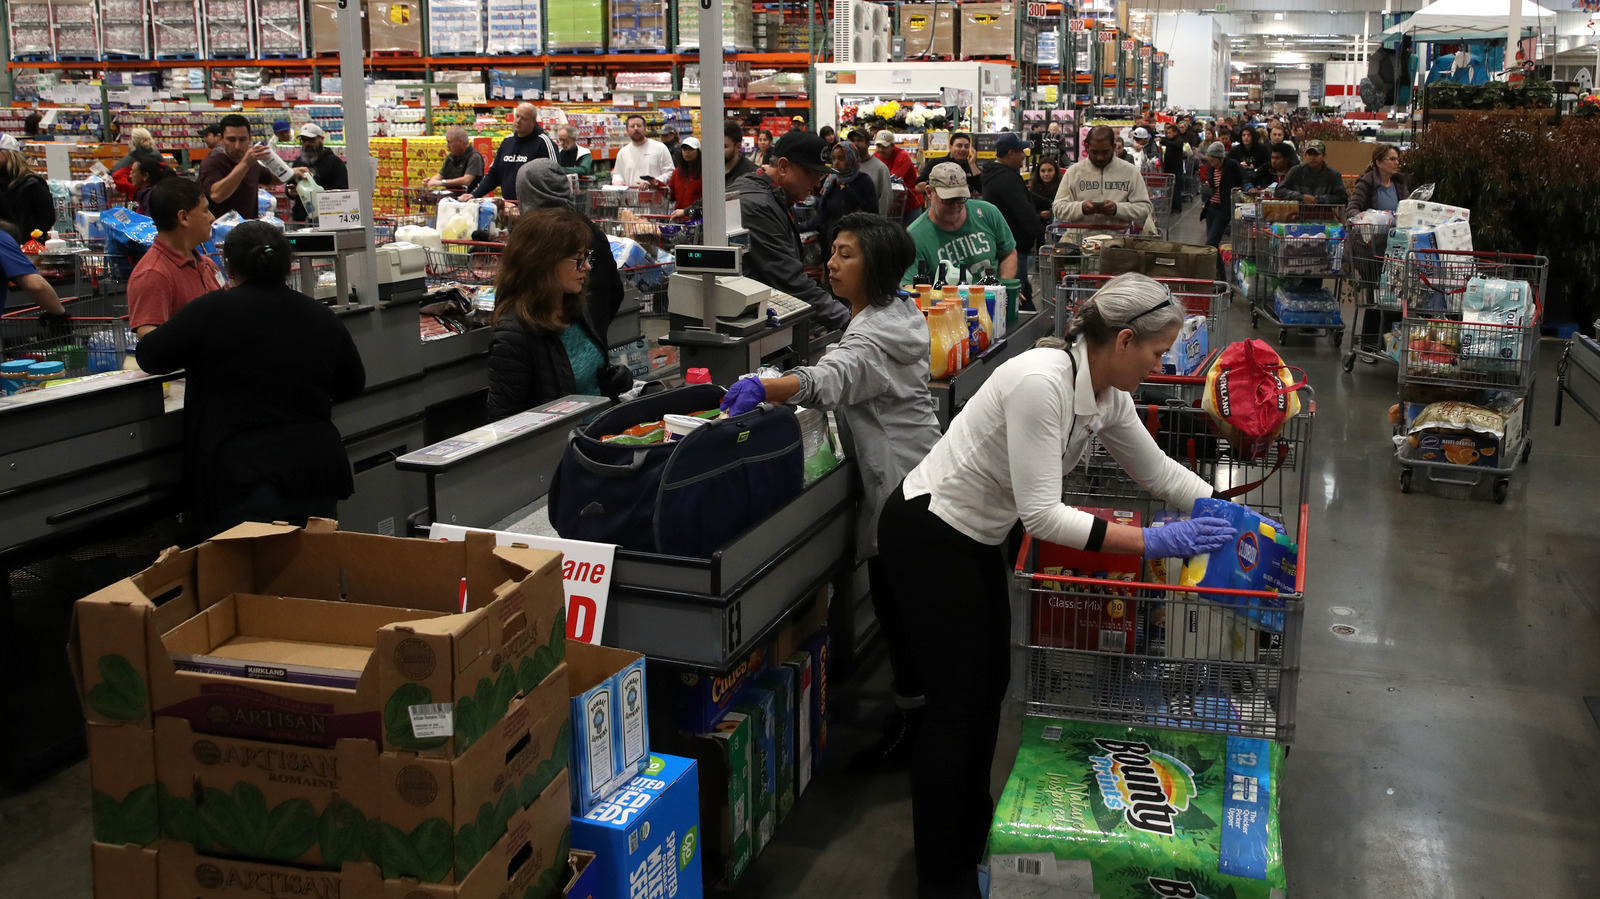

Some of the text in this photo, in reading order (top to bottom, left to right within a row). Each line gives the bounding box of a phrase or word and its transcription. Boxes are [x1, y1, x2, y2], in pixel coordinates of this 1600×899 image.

[1029, 4, 1045, 16] 300
[1069, 21, 1083, 31] 302
[1100, 32, 1111, 42] 304
[1122, 41, 1133, 50] 306
[1080, 180, 1100, 191] OLD
[339, 213, 360, 223] 74.99
[937, 231, 991, 264] CELTICS
[1238, 540, 1258, 566] CLOROX
[562, 553, 606, 584] ane
[1048, 597, 1103, 611] Classic Mix
[248, 666, 285, 676] KIRKLAND
[233, 707, 327, 735] ARTISAN
[224, 743, 339, 781] ARTISAN
[1237, 752, 1257, 767] 12
[268, 773, 340, 790] ROMAINE
[1089, 755, 1124, 810] prints
[1094, 738, 1178, 836] Bounty
[1044, 772, 1074, 827] Inspired
[1064, 781, 1091, 832] Nature
[1227, 807, 1236, 829] Upper
[1242, 809, 1250, 835] Quicker
[1249, 810, 1258, 824] The
[684, 833, 695, 858] Go
[647, 844, 664, 899] MIXE
[666, 830, 678, 898] SPROUTED
[225, 867, 343, 899] ARTISAN
